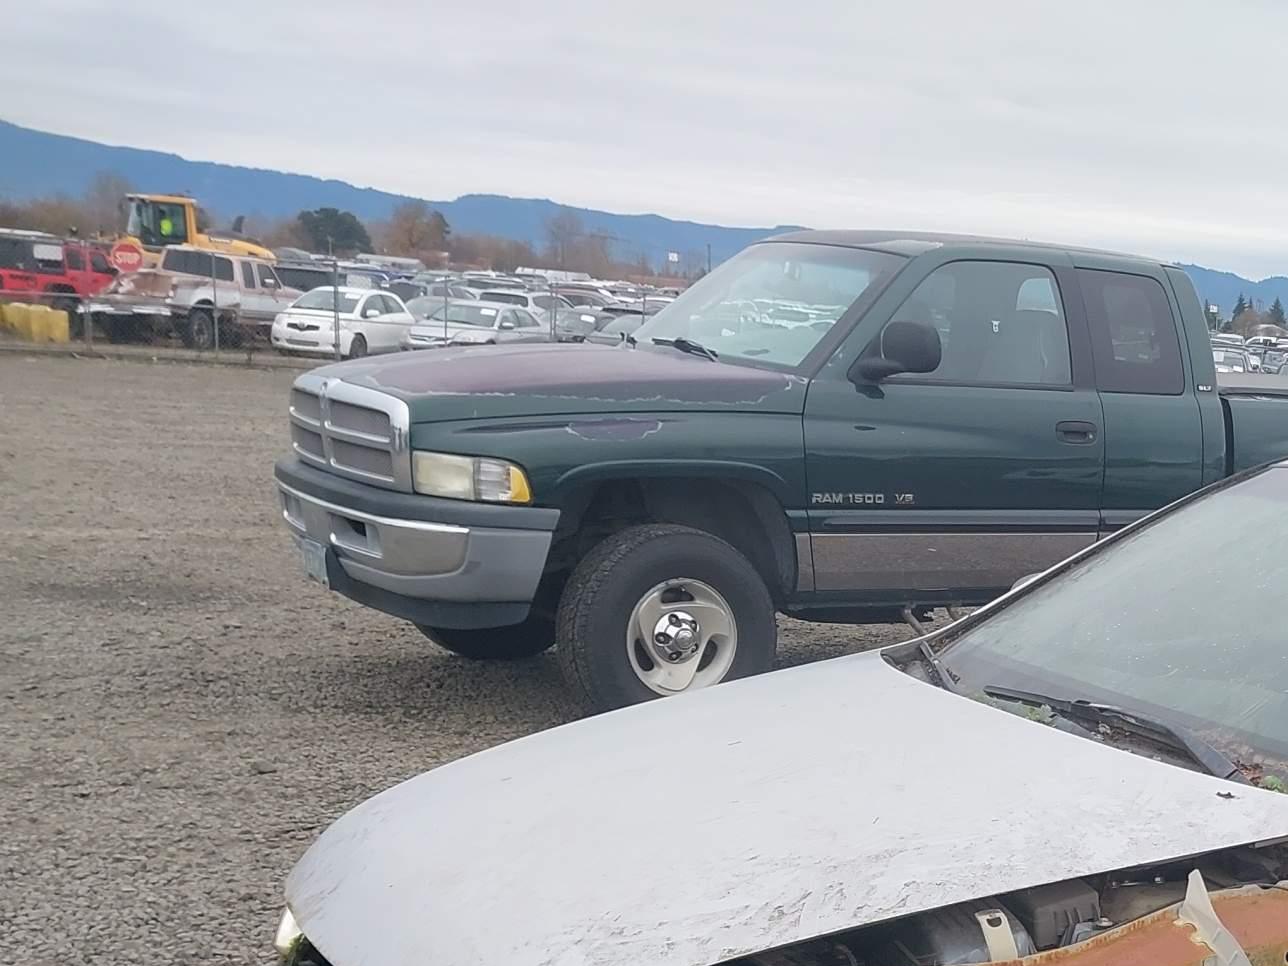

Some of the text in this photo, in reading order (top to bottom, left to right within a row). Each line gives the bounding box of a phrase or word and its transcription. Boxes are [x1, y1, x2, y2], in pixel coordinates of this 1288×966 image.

[115, 251, 140, 265] STOP
[811, 493, 843, 504] RAM
[849, 493, 885, 504] 1500
